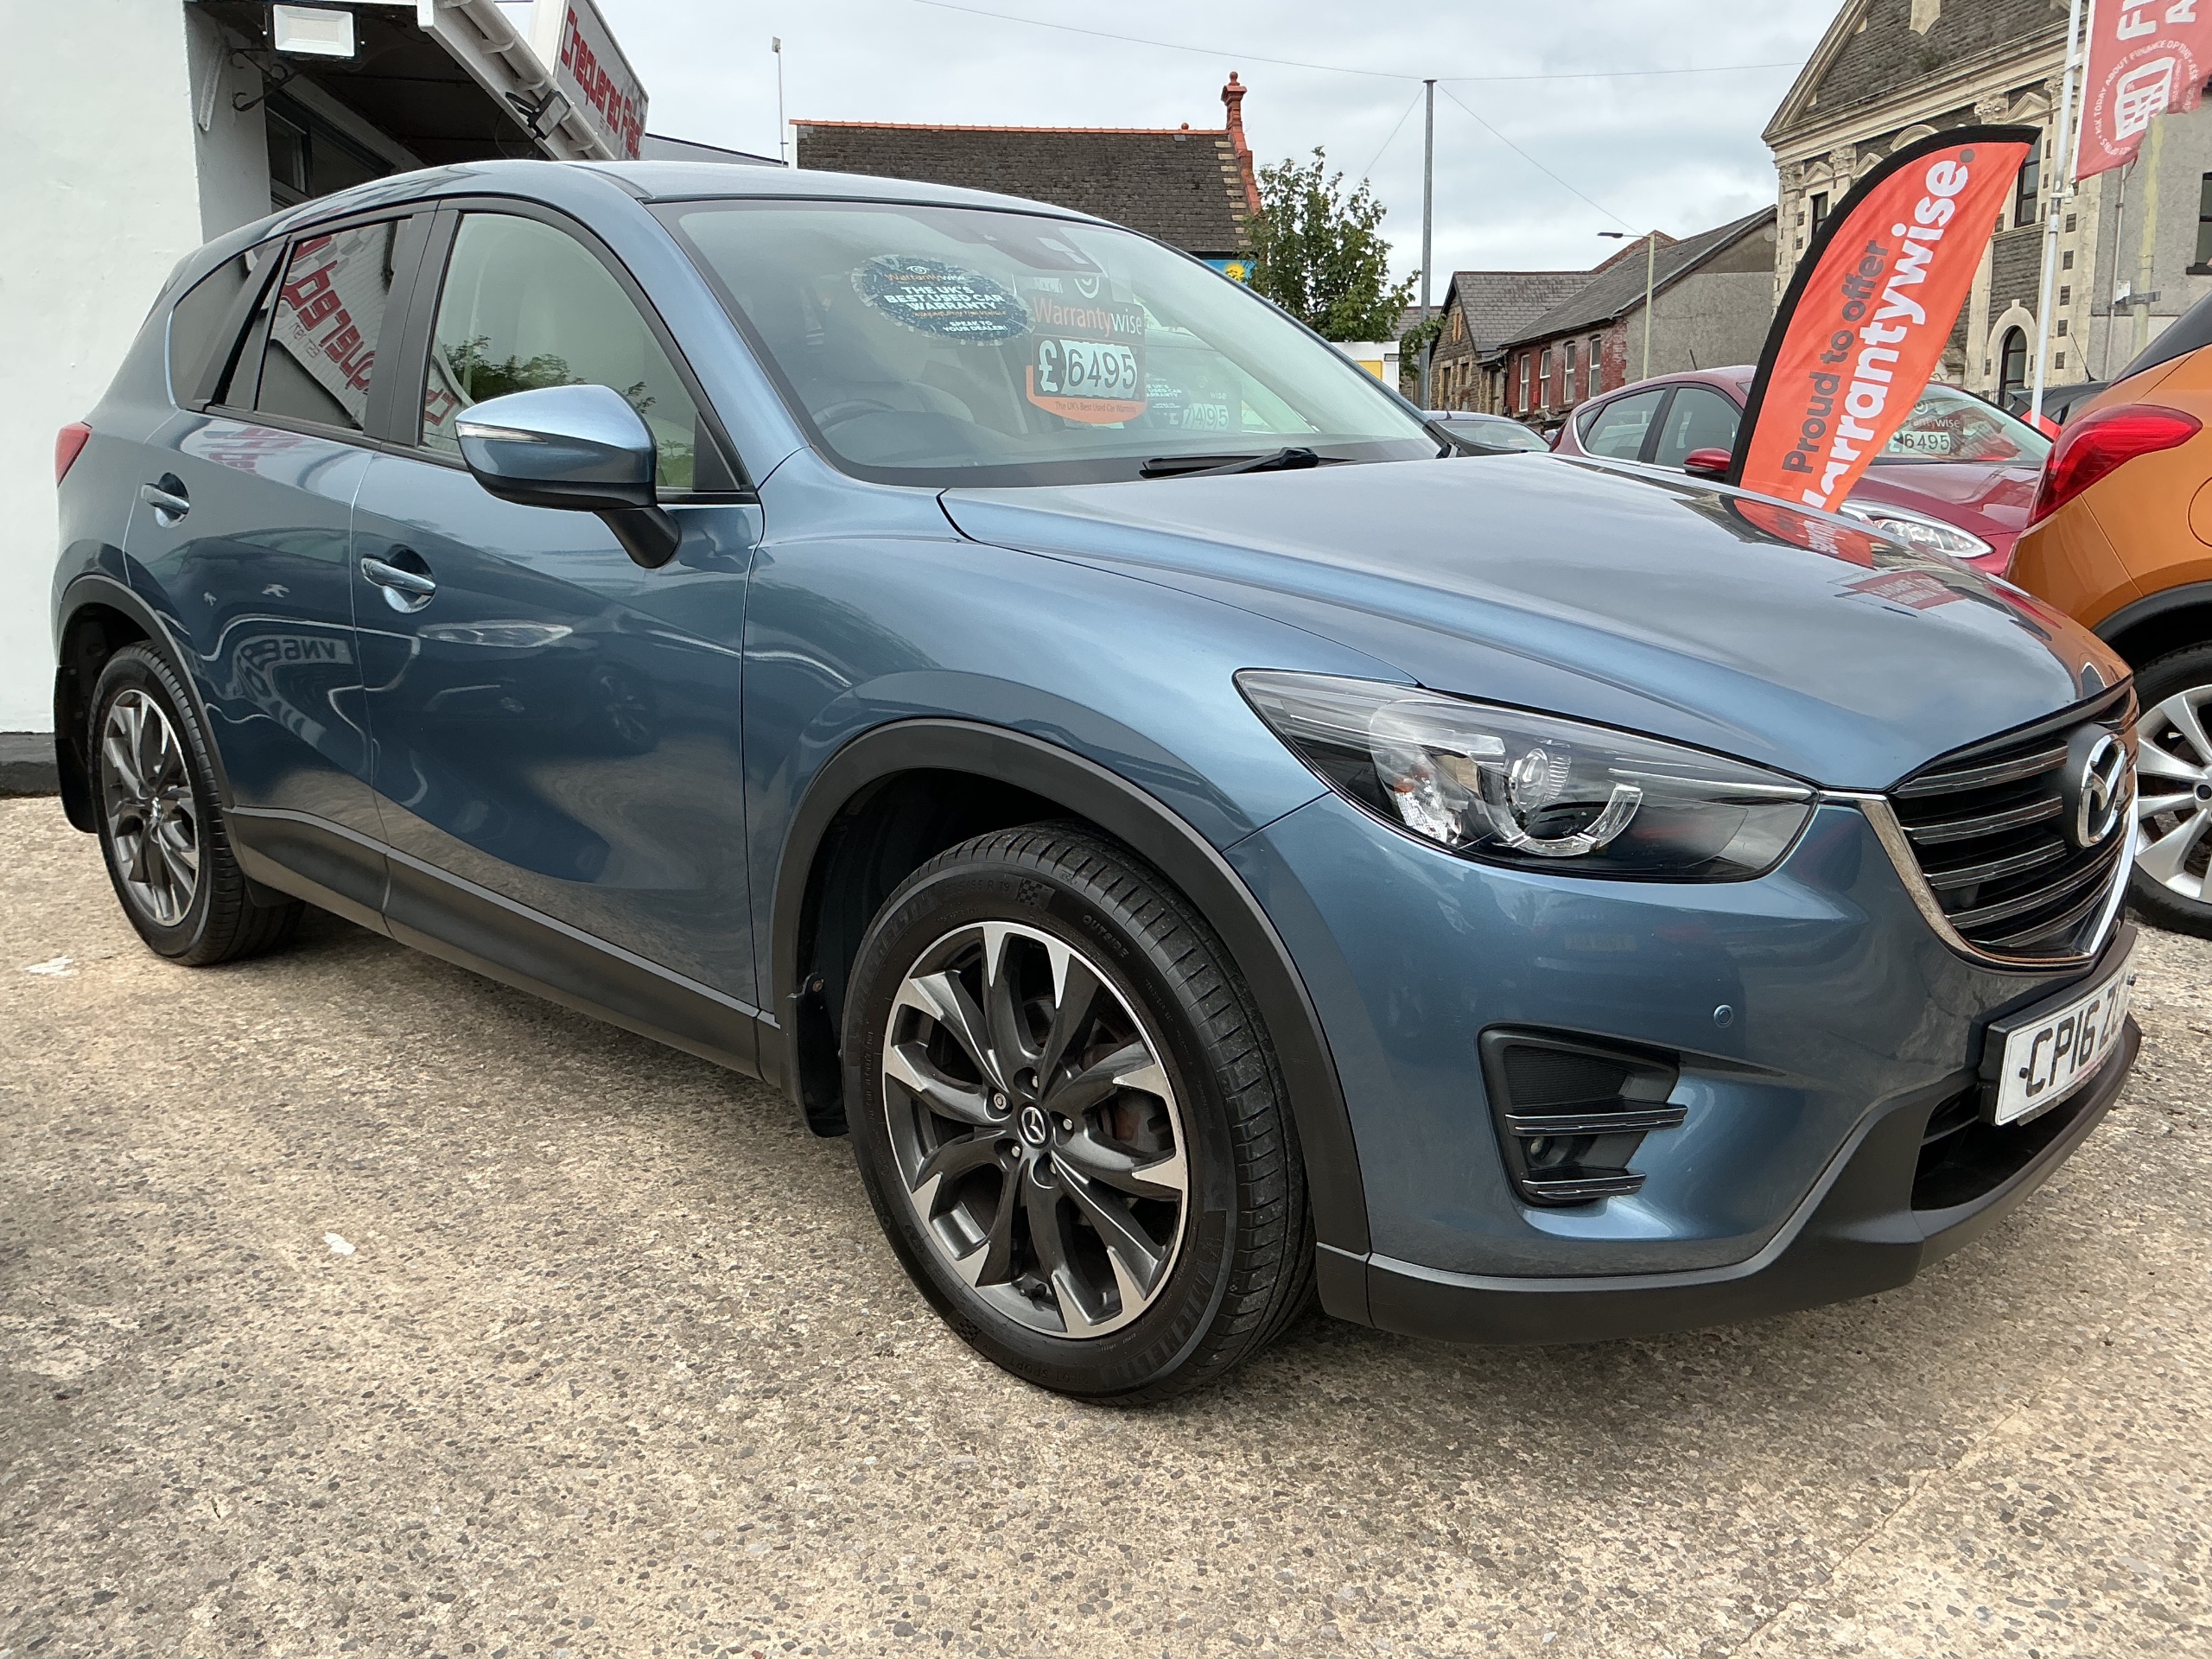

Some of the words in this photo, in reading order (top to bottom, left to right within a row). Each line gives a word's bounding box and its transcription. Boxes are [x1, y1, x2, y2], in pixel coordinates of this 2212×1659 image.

[561, 5, 623, 135] Chequered
[2094, 86, 2107, 117] TODAY
[2105, 57, 2128, 86] ABOUT
[883, 295, 928, 303] BEST
[927, 295, 970, 303] USED
[972, 294, 1006, 302] CAR
[900, 286, 937, 295] THE
[937, 286, 975, 295] UK'S
[906, 302, 998, 311] WARRANTY
[1033, 296, 1143, 338] Warrantywise
[1781, 371, 1840, 474] Proud
[1819, 329, 1854, 364] to
[1841, 239, 1888, 321] offer
[1055, 401, 1066, 410] The
[1080, 402, 1093, 411] Best
[1093, 403, 1106, 412] Used
[1082, 914, 1130, 959] OUTSIDE
[1007, 1360, 1050, 1379] SPORT
